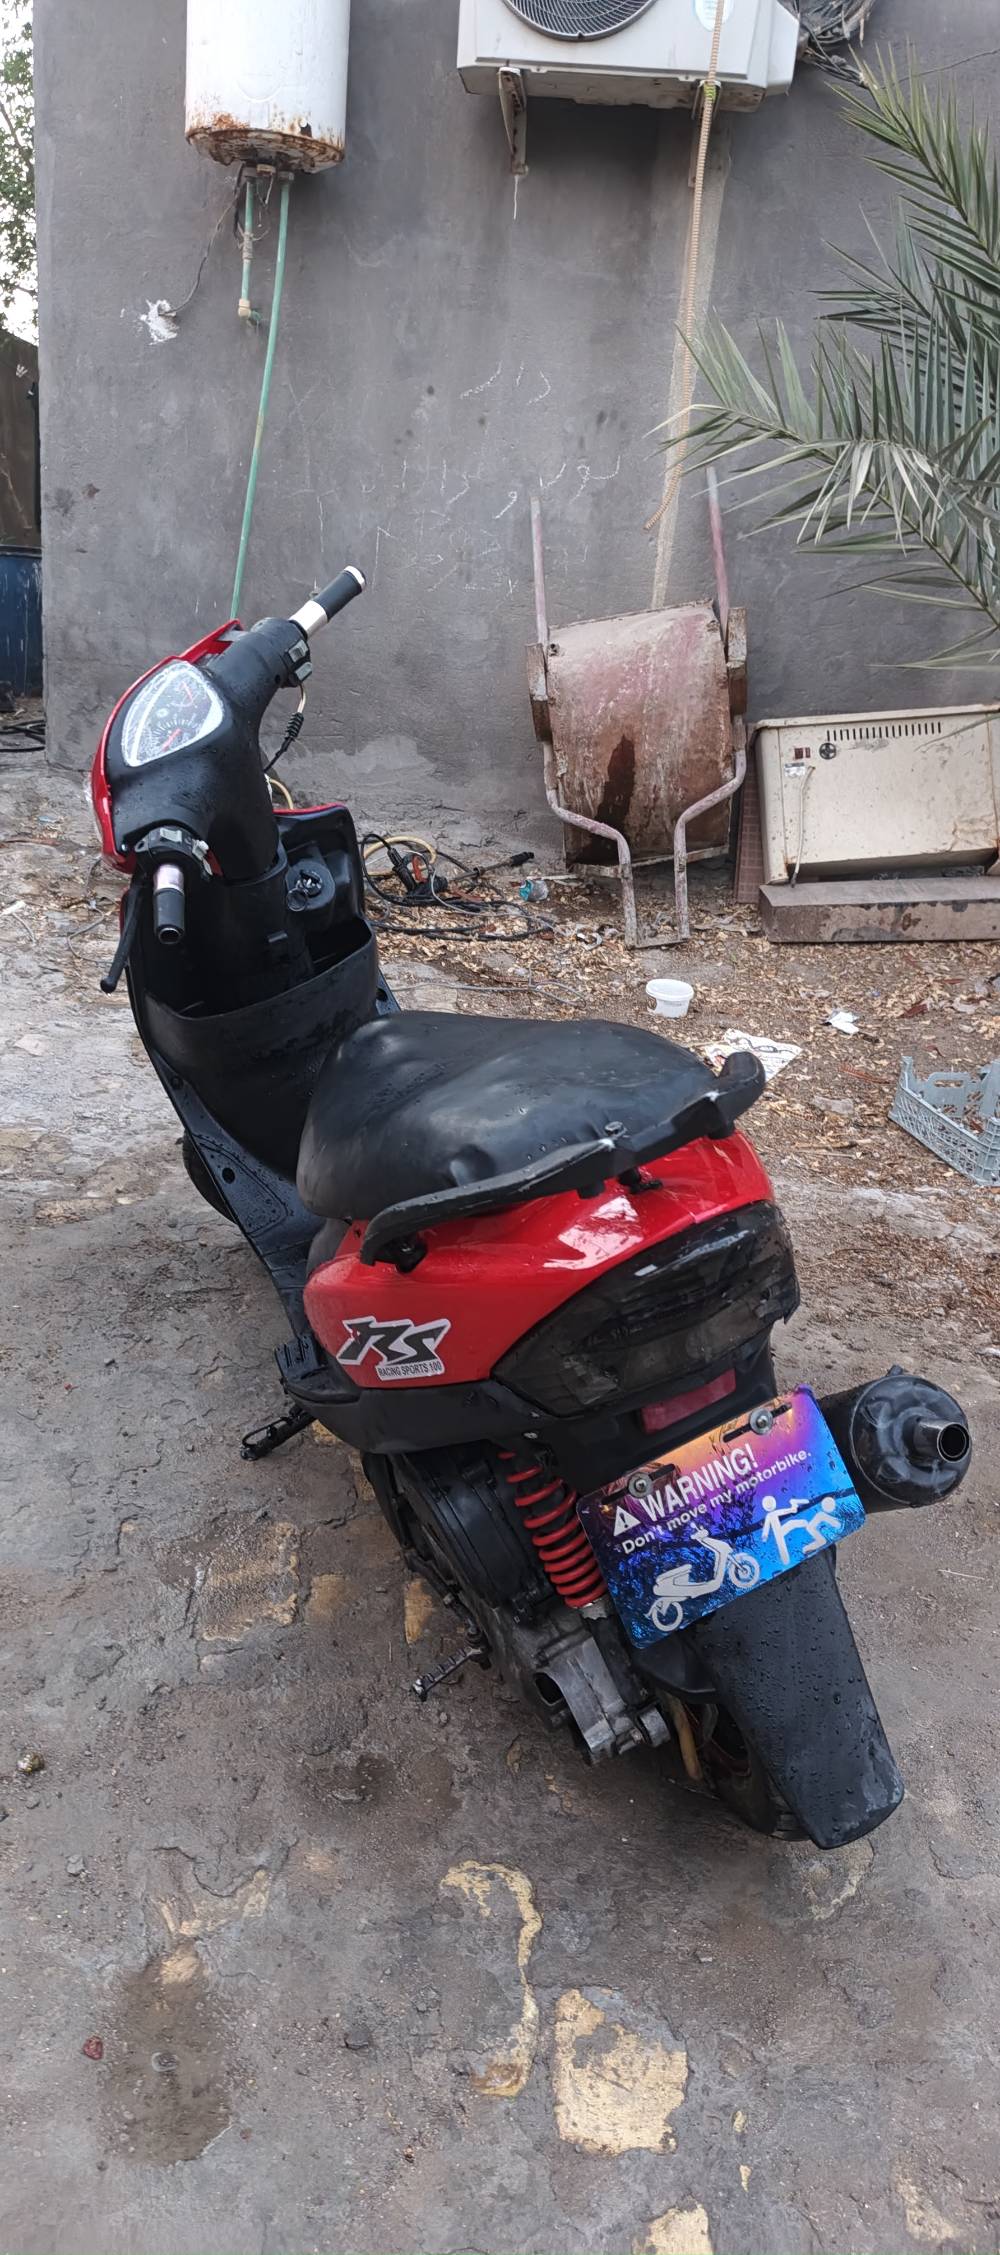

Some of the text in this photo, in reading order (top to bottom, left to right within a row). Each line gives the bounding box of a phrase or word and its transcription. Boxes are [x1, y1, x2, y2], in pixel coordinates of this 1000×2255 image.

[377, 1361, 443, 1377] RACING SPORTS 100
[621, 1449, 812, 1555] Don't move my motorbike.
[639, 1443, 760, 1523] WARNING!
